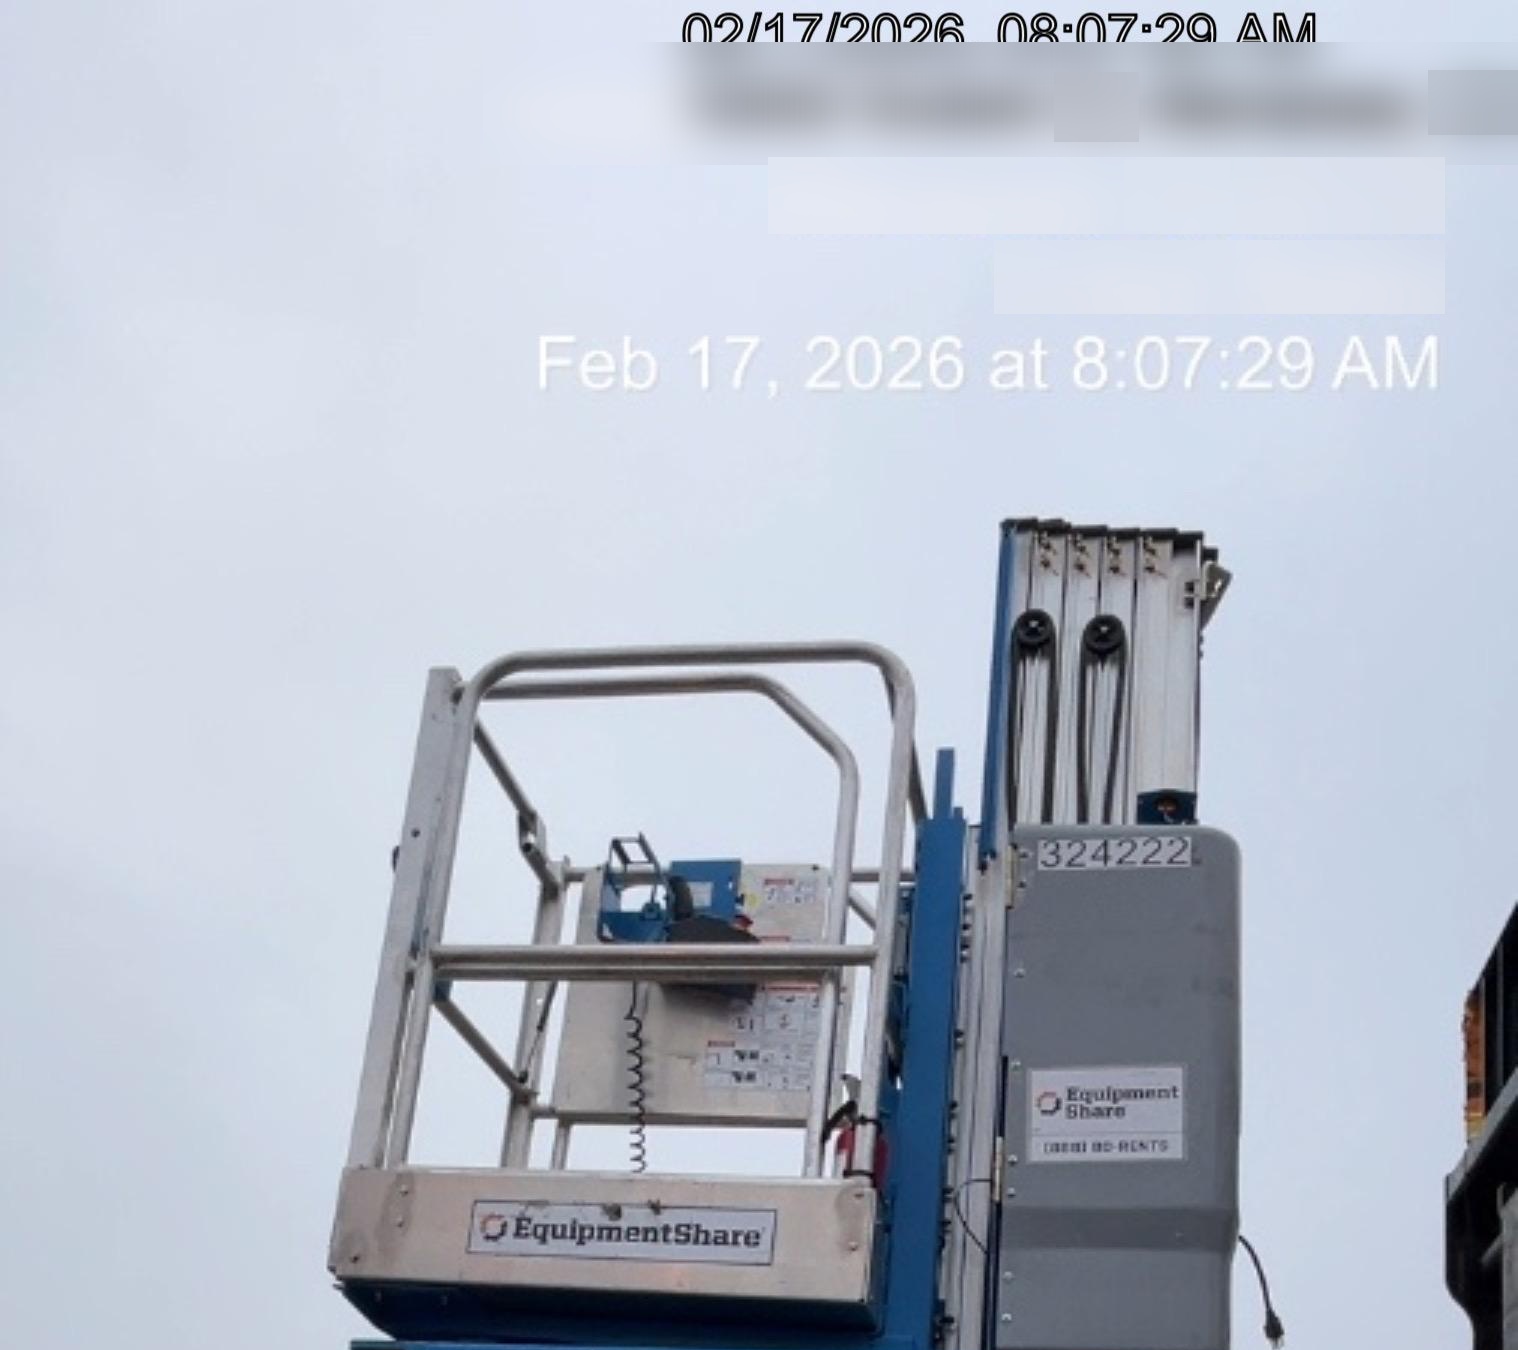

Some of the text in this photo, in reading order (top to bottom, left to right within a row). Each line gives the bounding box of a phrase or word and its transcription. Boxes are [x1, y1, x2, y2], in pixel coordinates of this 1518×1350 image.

[1040, 837, 1189, 868] 324222
[1066, 1086, 1180, 1104] Equipment
[1066, 1103, 1126, 1120] Share
[512, 1215, 762, 1249] EquipmentShare
